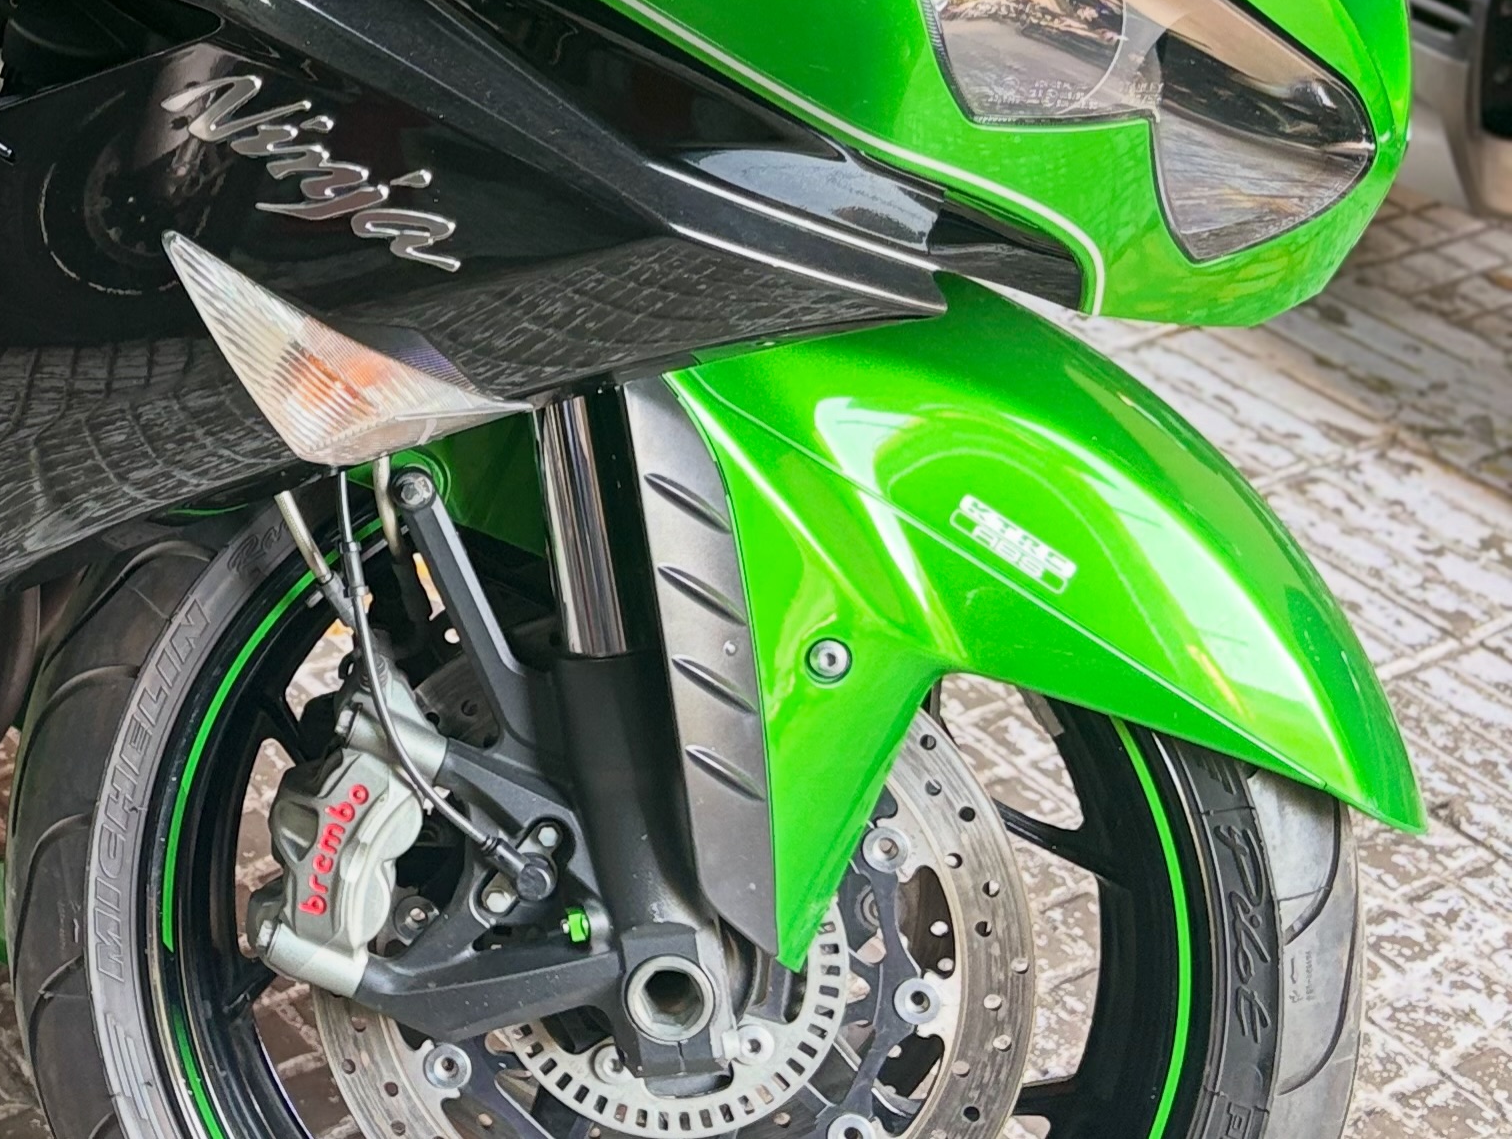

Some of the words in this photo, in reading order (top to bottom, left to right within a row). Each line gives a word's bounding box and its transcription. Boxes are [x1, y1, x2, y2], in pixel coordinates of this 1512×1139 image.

[160, 74, 462, 273] Ninja
[93, 598, 211, 983] MICHELIN
[298, 783, 369, 917] brembo
[1213, 823, 1272, 1044] Pilot
